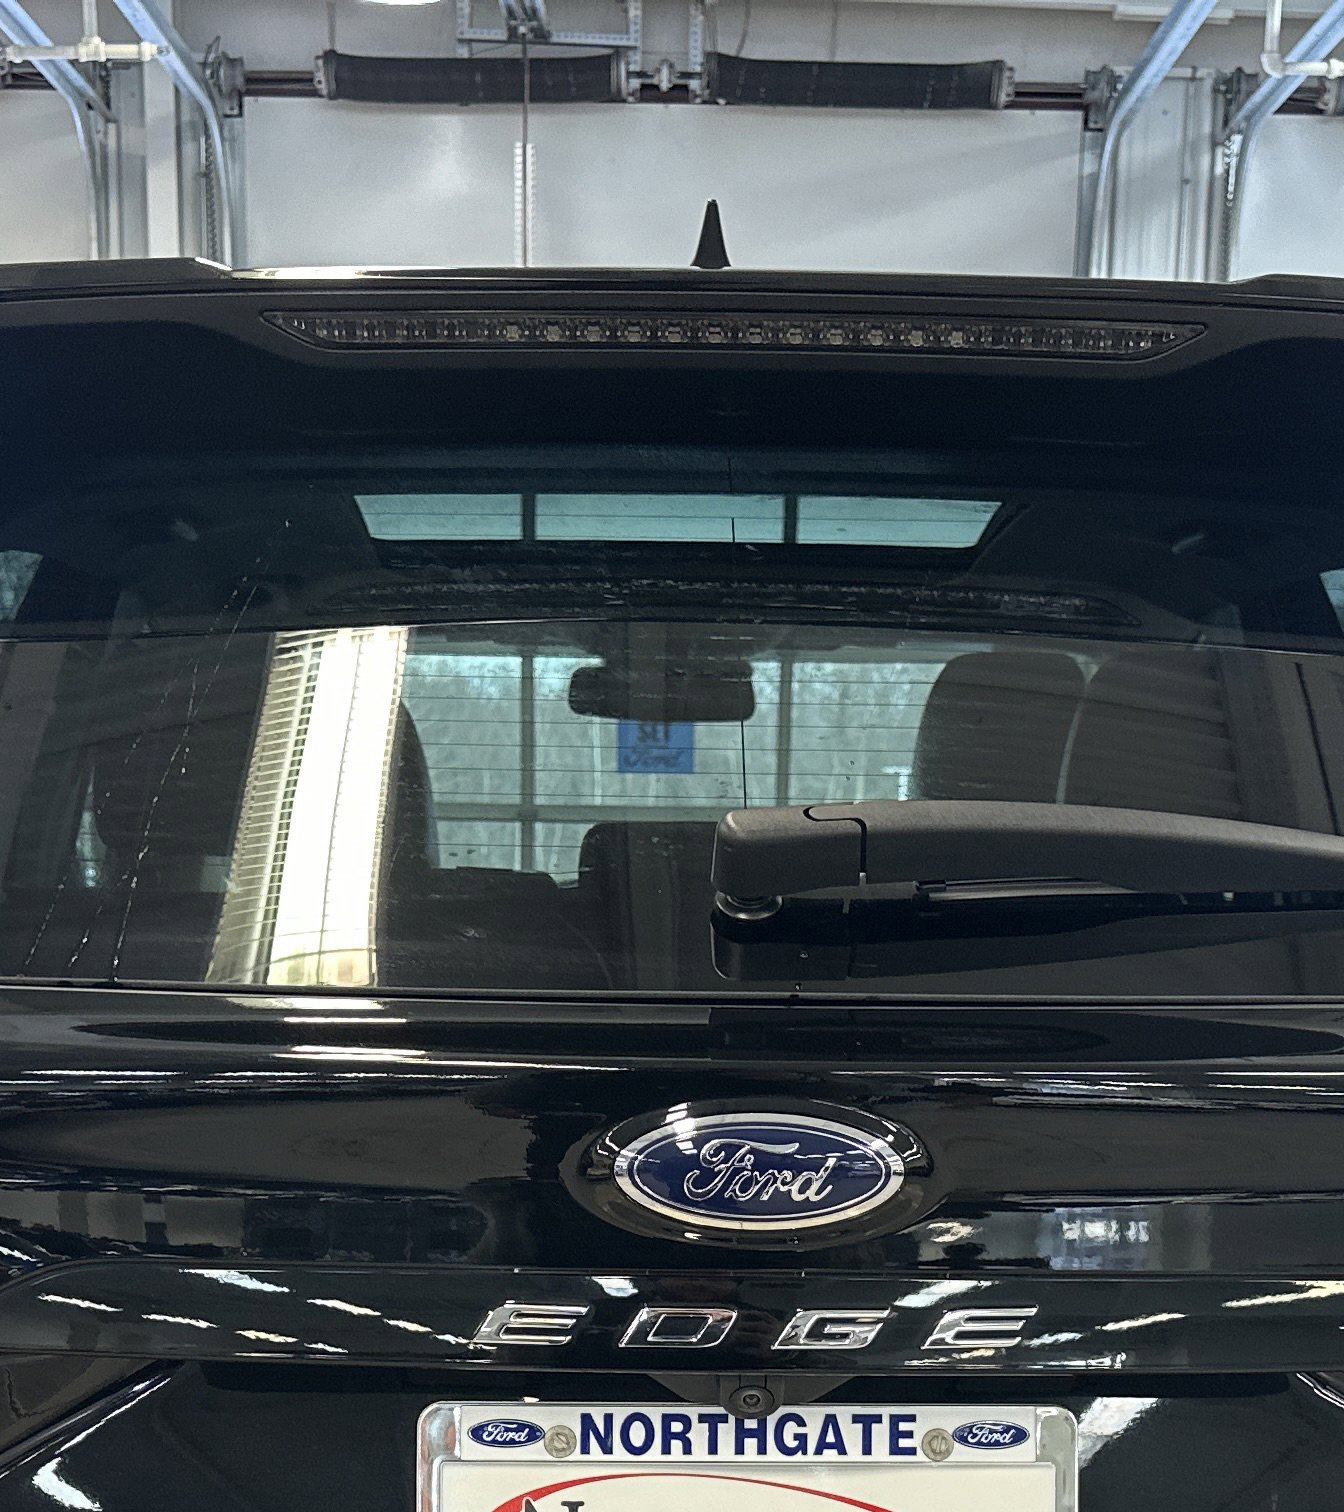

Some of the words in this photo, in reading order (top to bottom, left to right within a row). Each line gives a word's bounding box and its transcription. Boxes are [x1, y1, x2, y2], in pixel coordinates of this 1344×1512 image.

[683, 1138, 837, 1203] Ford
[471, 1300, 1040, 1350] EDGE
[579, 1413, 918, 1456] NORTHGATE
